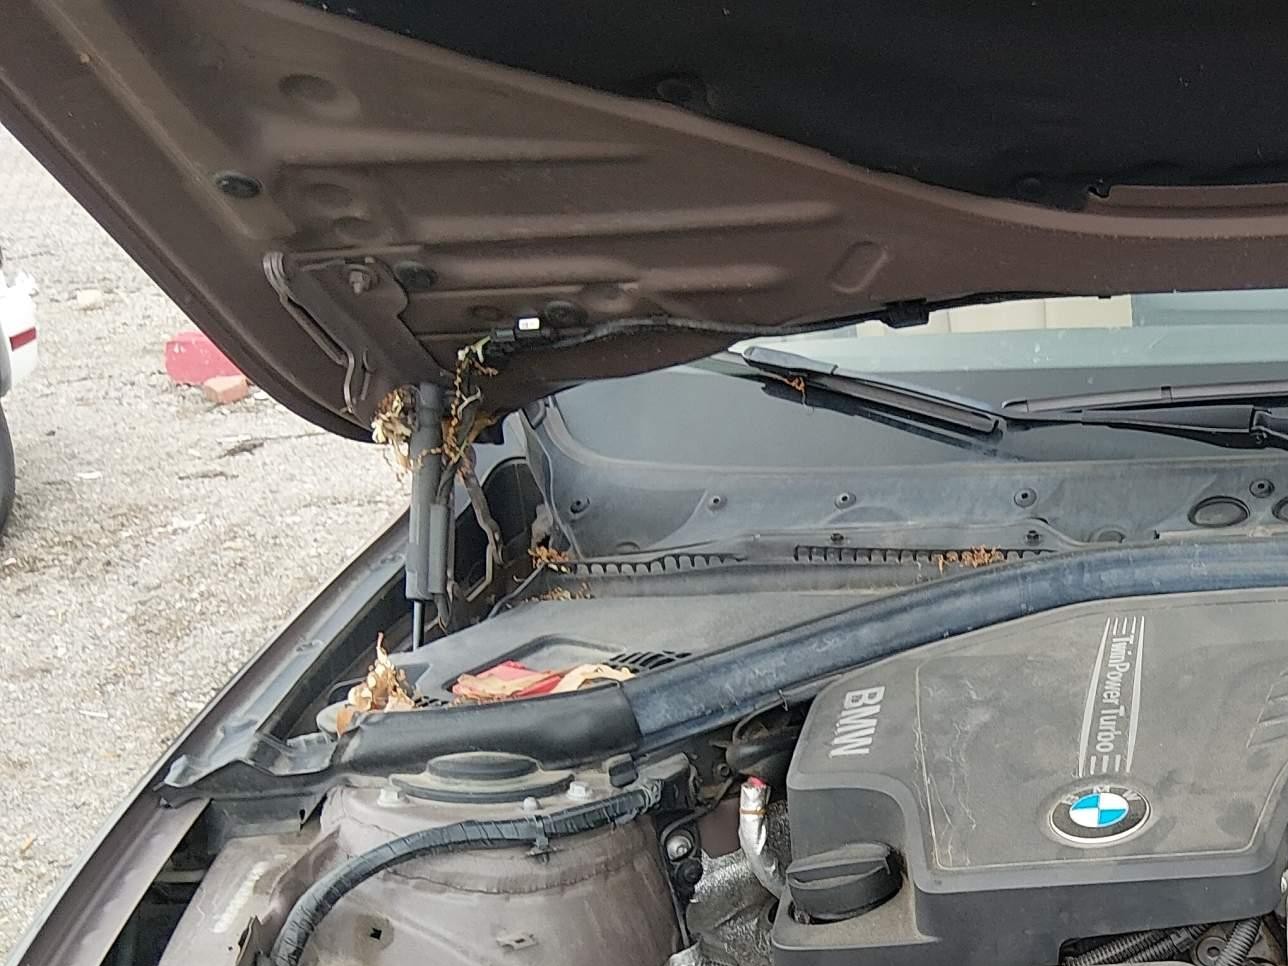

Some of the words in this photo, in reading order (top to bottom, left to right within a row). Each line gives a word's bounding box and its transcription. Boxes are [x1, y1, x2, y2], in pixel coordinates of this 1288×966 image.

[1102, 634, 1135, 705] TwinPower
[831, 686, 886, 758] BMW
[1096, 705, 1126, 753] Turbo
